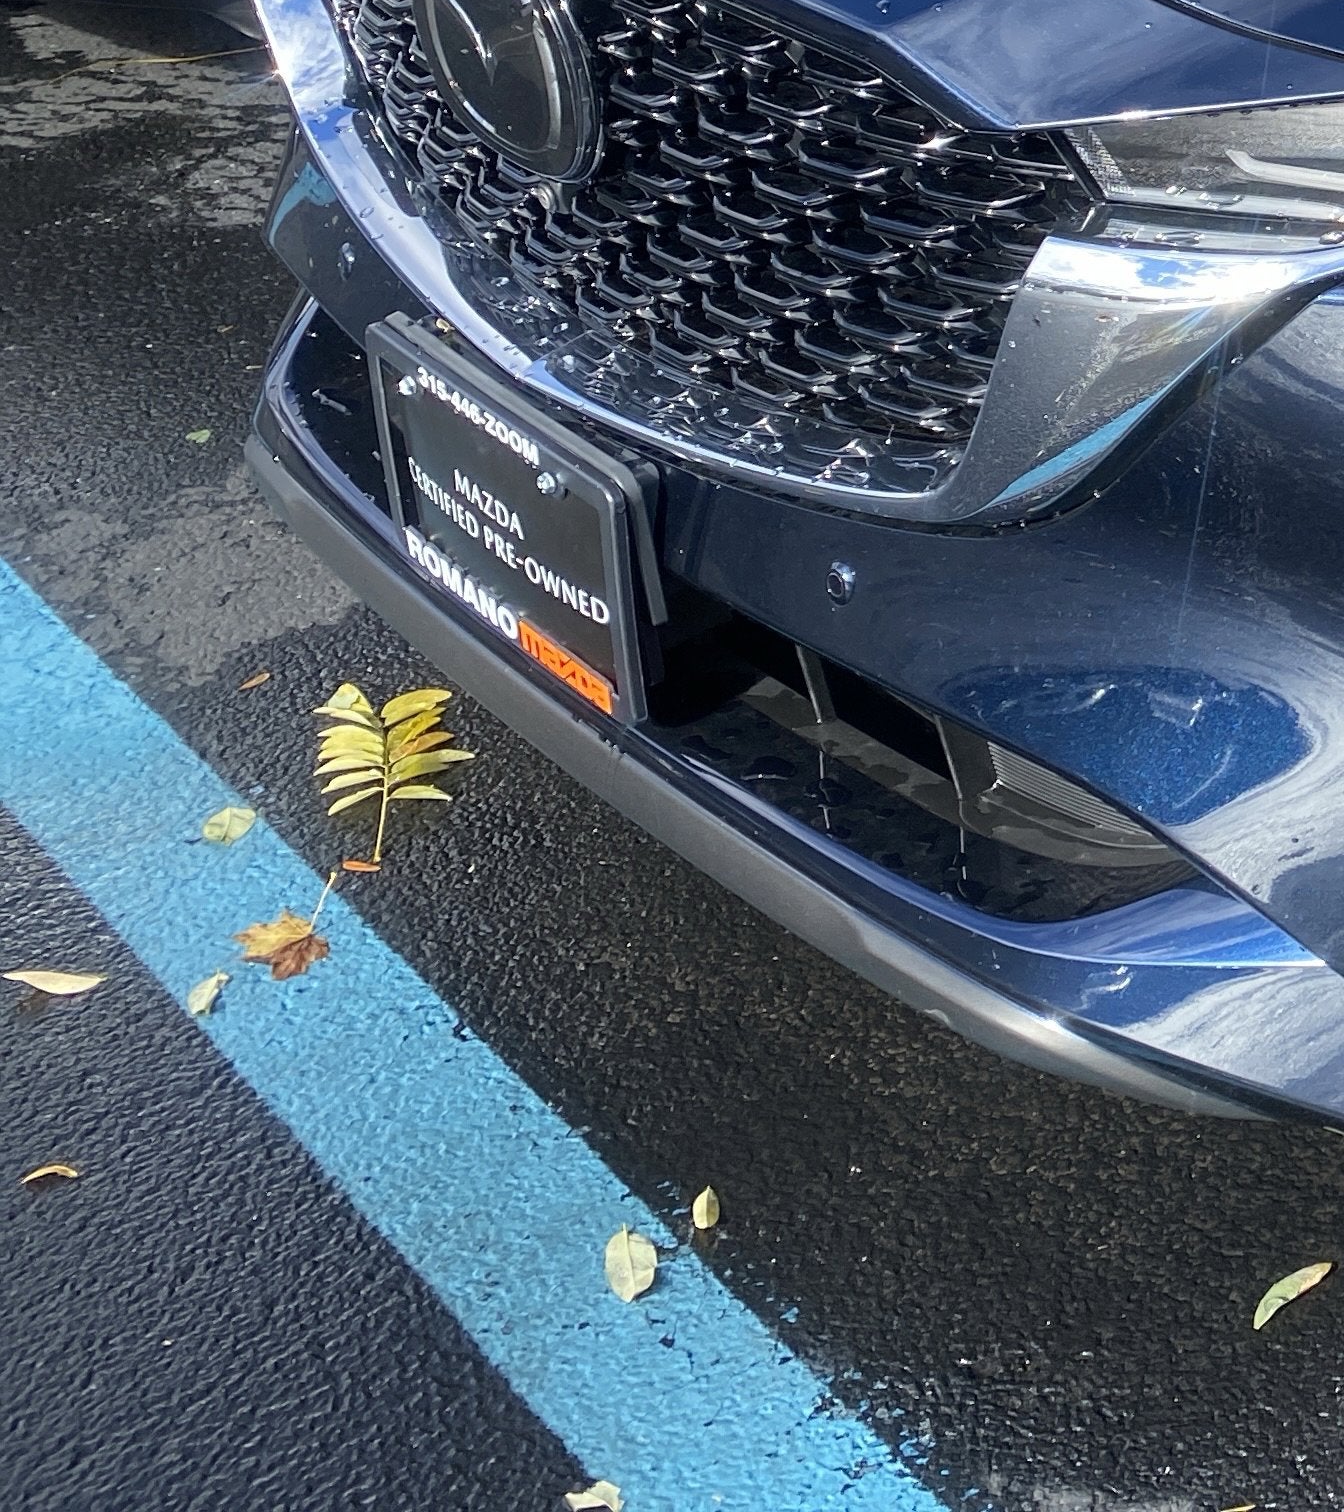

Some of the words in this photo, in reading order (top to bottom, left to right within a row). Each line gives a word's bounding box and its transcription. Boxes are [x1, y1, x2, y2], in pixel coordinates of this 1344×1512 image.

[416, 365, 541, 468] 315-446-ZOOM
[407, 456, 480, 540] CERTIFIED
[483, 525, 610, 626] PRE-OWNED
[452, 468, 525, 541] MAZDA
[404, 527, 519, 642] ROMANO
